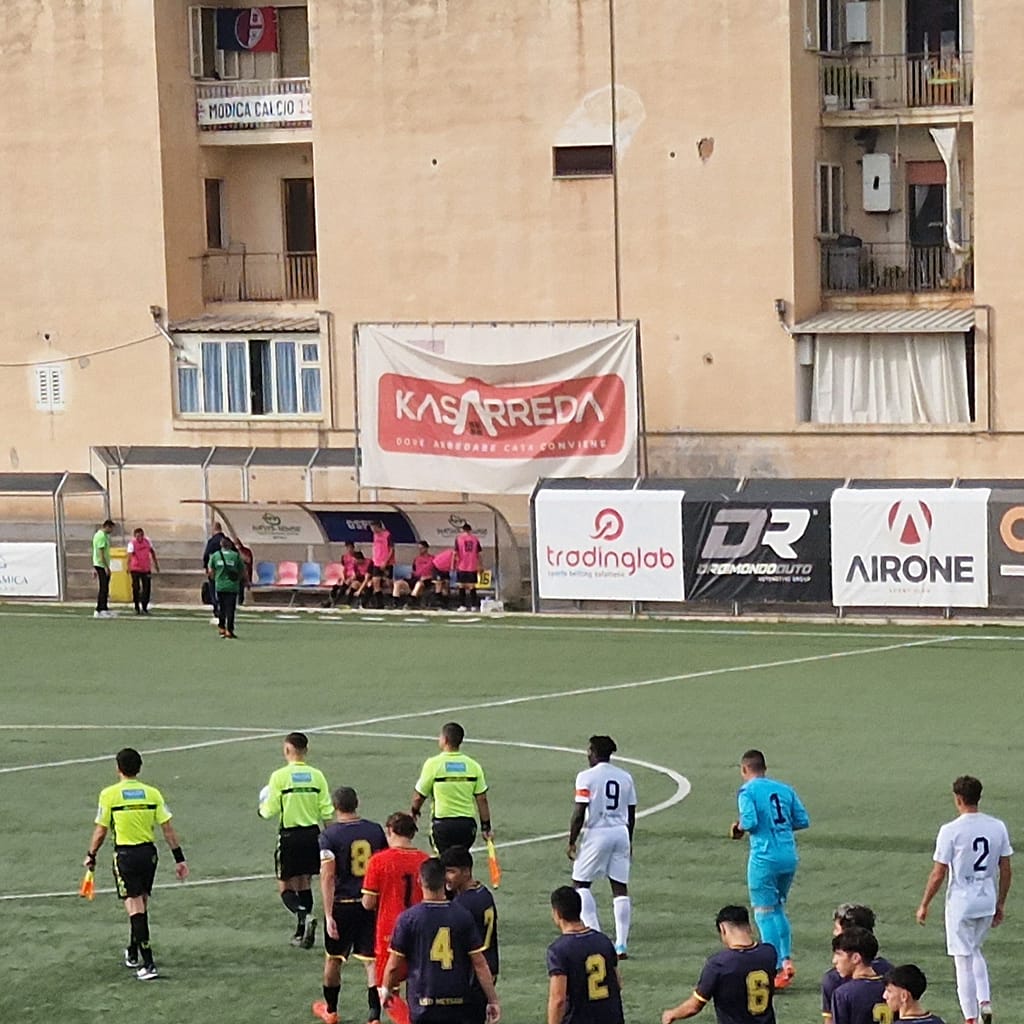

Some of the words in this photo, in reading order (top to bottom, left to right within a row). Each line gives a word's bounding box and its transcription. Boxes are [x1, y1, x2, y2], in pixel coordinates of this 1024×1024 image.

[208, 101, 252, 119] MODICA
[254, 99, 295, 117] CALCIO
[395, 389, 605, 437] KASARREDA
[701, 508, 812, 560] DR
[546, 545, 675, 576] tradinglab
[845, 554, 975, 584] AIRONE
[0, 575, 30, 585] MICA
[605, 779, 620, 811] 9
[769, 792, 787, 825] 1
[350, 839, 372, 878] 8
[972, 836, 990, 873] 2
[429, 926, 455, 971] 4
[584, 953, 610, 1001] 2
[746, 969, 770, 1015] 6
